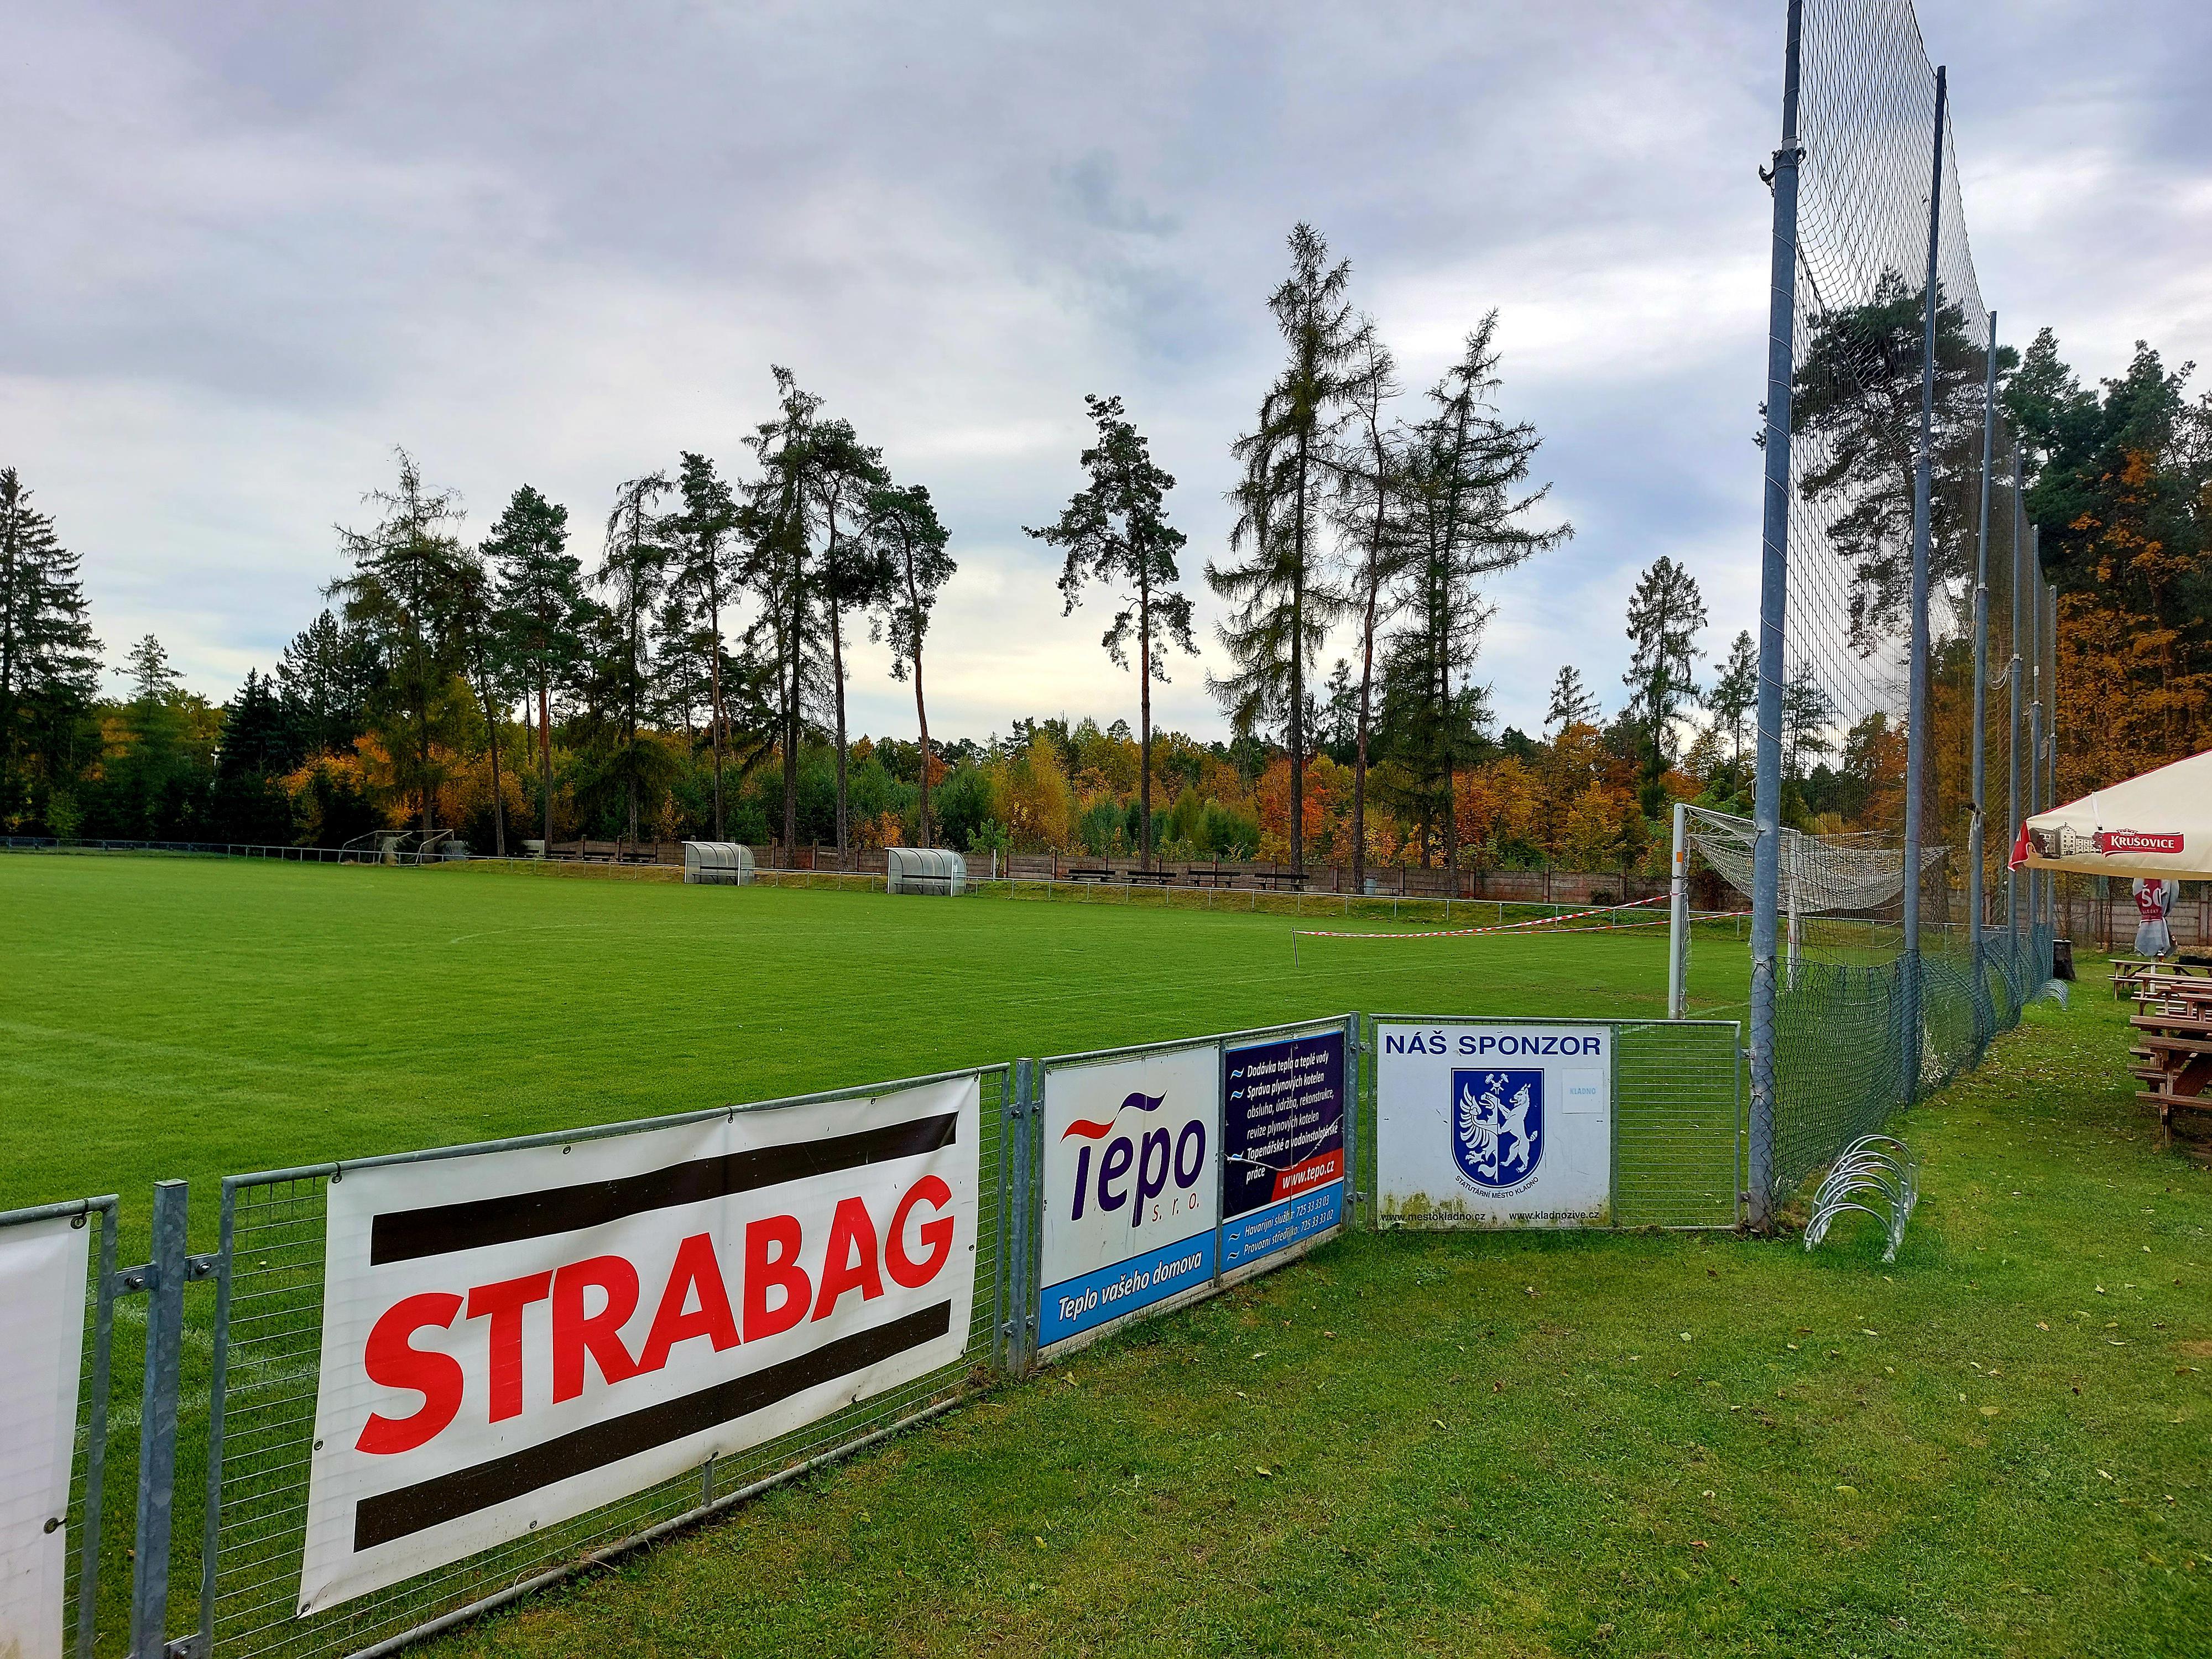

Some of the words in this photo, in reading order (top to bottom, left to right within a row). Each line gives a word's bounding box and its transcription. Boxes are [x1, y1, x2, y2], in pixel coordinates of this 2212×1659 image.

[2111, 835, 2174, 849] KRUŠOVICE
[1385, 1030, 1447, 1055] NÁŠ
[1458, 1036, 1601, 1056] SPONZOR
[1247, 1061, 1276, 1078] Dodávka
[1277, 1058, 1293, 1073] tepla
[1294, 1059, 1299, 1068] a
[1300, 1052, 1315, 1069] teplé
[1316, 1050, 1329, 1065] vody
[1247, 1082, 1271, 1101] Správa
[1271, 1074, 1302, 1096] plynových
[1303, 1071, 1324, 1086] kotelen
[1247, 1100, 1274, 1119] obsluha,
[1276, 1096, 1298, 1113] údržba,
[1300, 1087, 1334, 1107] rekonstrukce,
[1247, 1124, 1266, 1140] revize
[1267, 1114, 1298, 1138] plynových
[1299, 1109, 1319, 1125] kotelen
[1247, 1137, 1284, 1161] Topenářské
[1285, 1140, 1290, 1149] a
[1290, 1121, 1338, 1148] vodoinstalatérské
[1246, 1166, 1266, 1185] práce
[1282, 1160, 1335, 1189] www.tepo.cz
[1455, 1175, 1491, 1198] STATUTÁRNÍ
[1491, 1191, 1514, 1199] MĚSTO
[1515, 1177, 1539, 1195] KLADNO
[1152, 1204, 1162, 1222] s.
[1172, 1198, 1179, 1216] r.
[1189, 1192, 1199, 1210] o.
[1244, 1215, 1274, 1237] Havarijní
[1296, 1203, 1306, 1218] 725
[1307, 1201, 1314, 1213] 33
[1315, 1197, 1322, 1209] 33
[1322, 1194, 1329, 1206] 03
[1381, 1212, 1486, 1221] www.mestokladno.cz
[1509, 1210, 1599, 1220] www.kladnozive.cz
[1244, 1234, 1271, 1256] Provozní
[1301, 1218, 1311, 1232] 725
[1311, 1214, 1319, 1227] 33
[1319, 1212, 1326, 1224] 33
[1327, 1209, 1334, 1221] 02
[1058, 1287, 1098, 1321] Teplo
[1102, 1269, 1150, 1305] vašeho
[1152, 1250, 1203, 1285] domova
[354, 1174, 956, 1455] STRABAG
